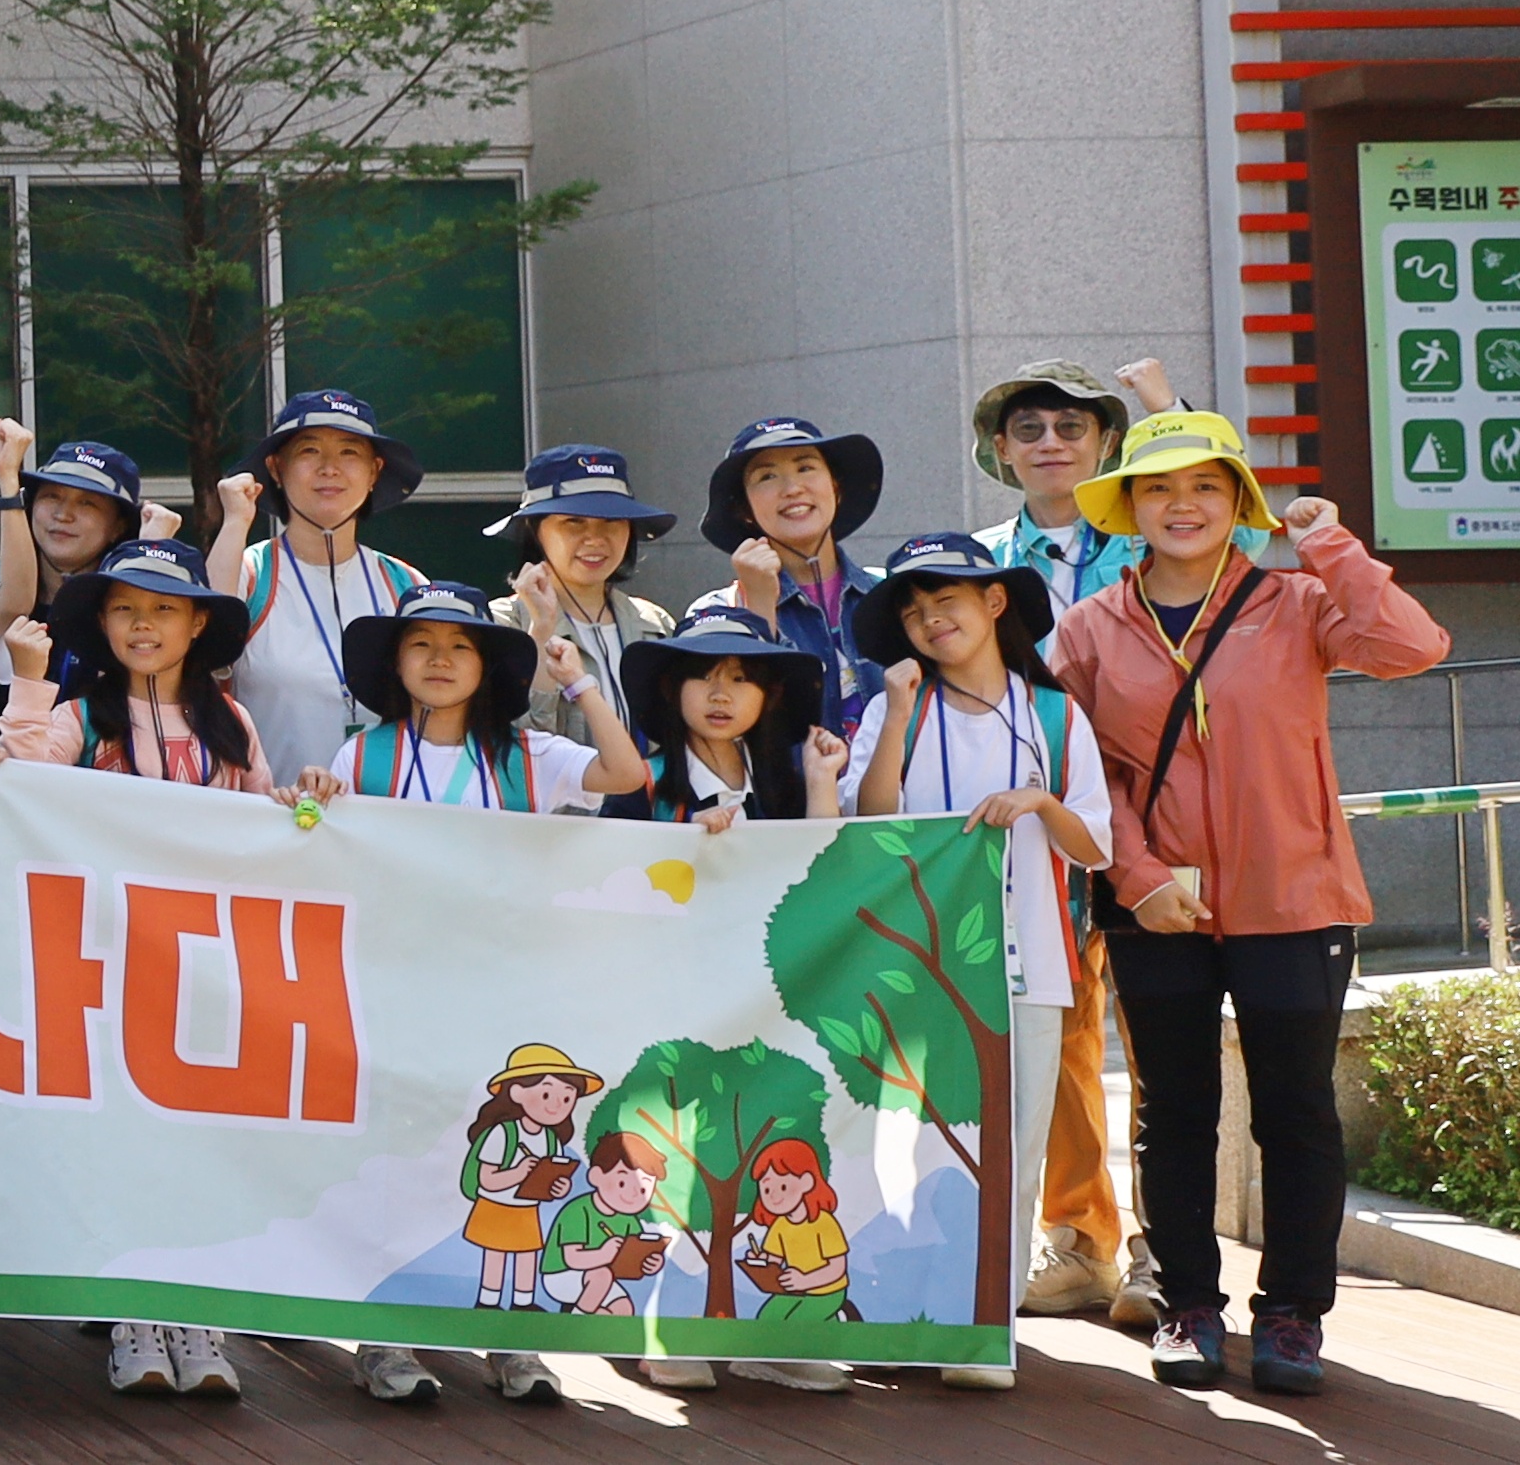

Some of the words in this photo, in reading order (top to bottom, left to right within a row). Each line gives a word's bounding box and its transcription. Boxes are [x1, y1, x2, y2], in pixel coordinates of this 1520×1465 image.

[1389, 187, 1488, 211] 수목원내
[331, 401, 358, 415] KIOM
[1152, 425, 1183, 438] KIOM
[77, 453, 106, 470] KIOM
[586, 464, 615, 475] KIOM
[910, 542, 944, 555] KIOM
[146, 549, 177, 562] KIOM
[422, 589, 455, 599] KIOM
[694, 613, 728, 627] KIOM
